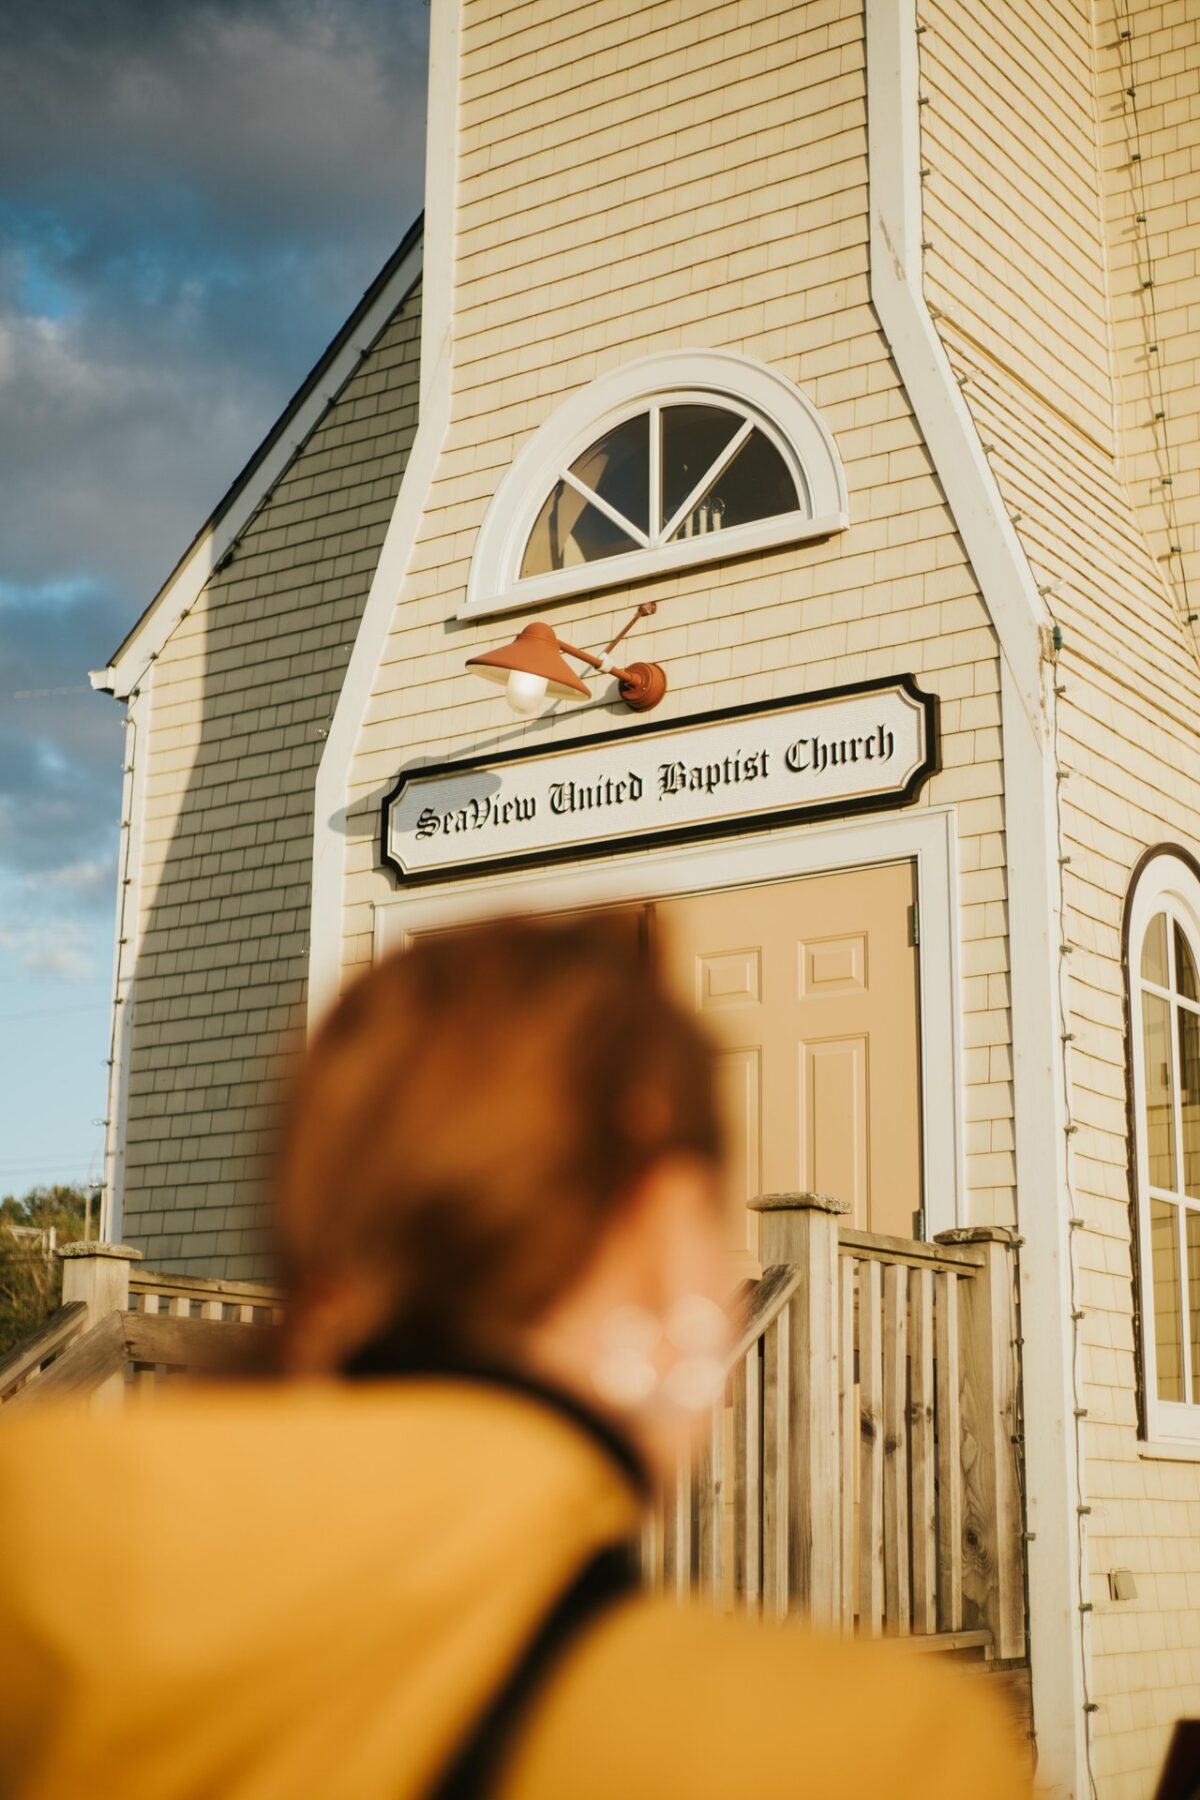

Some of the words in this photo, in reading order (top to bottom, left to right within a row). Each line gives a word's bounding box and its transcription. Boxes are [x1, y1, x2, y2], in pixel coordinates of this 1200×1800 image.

[414, 795, 537, 841] SeaView
[548, 771, 643, 818] United
[657, 749, 770, 800] Baptist
[784, 724, 895, 776] Church
